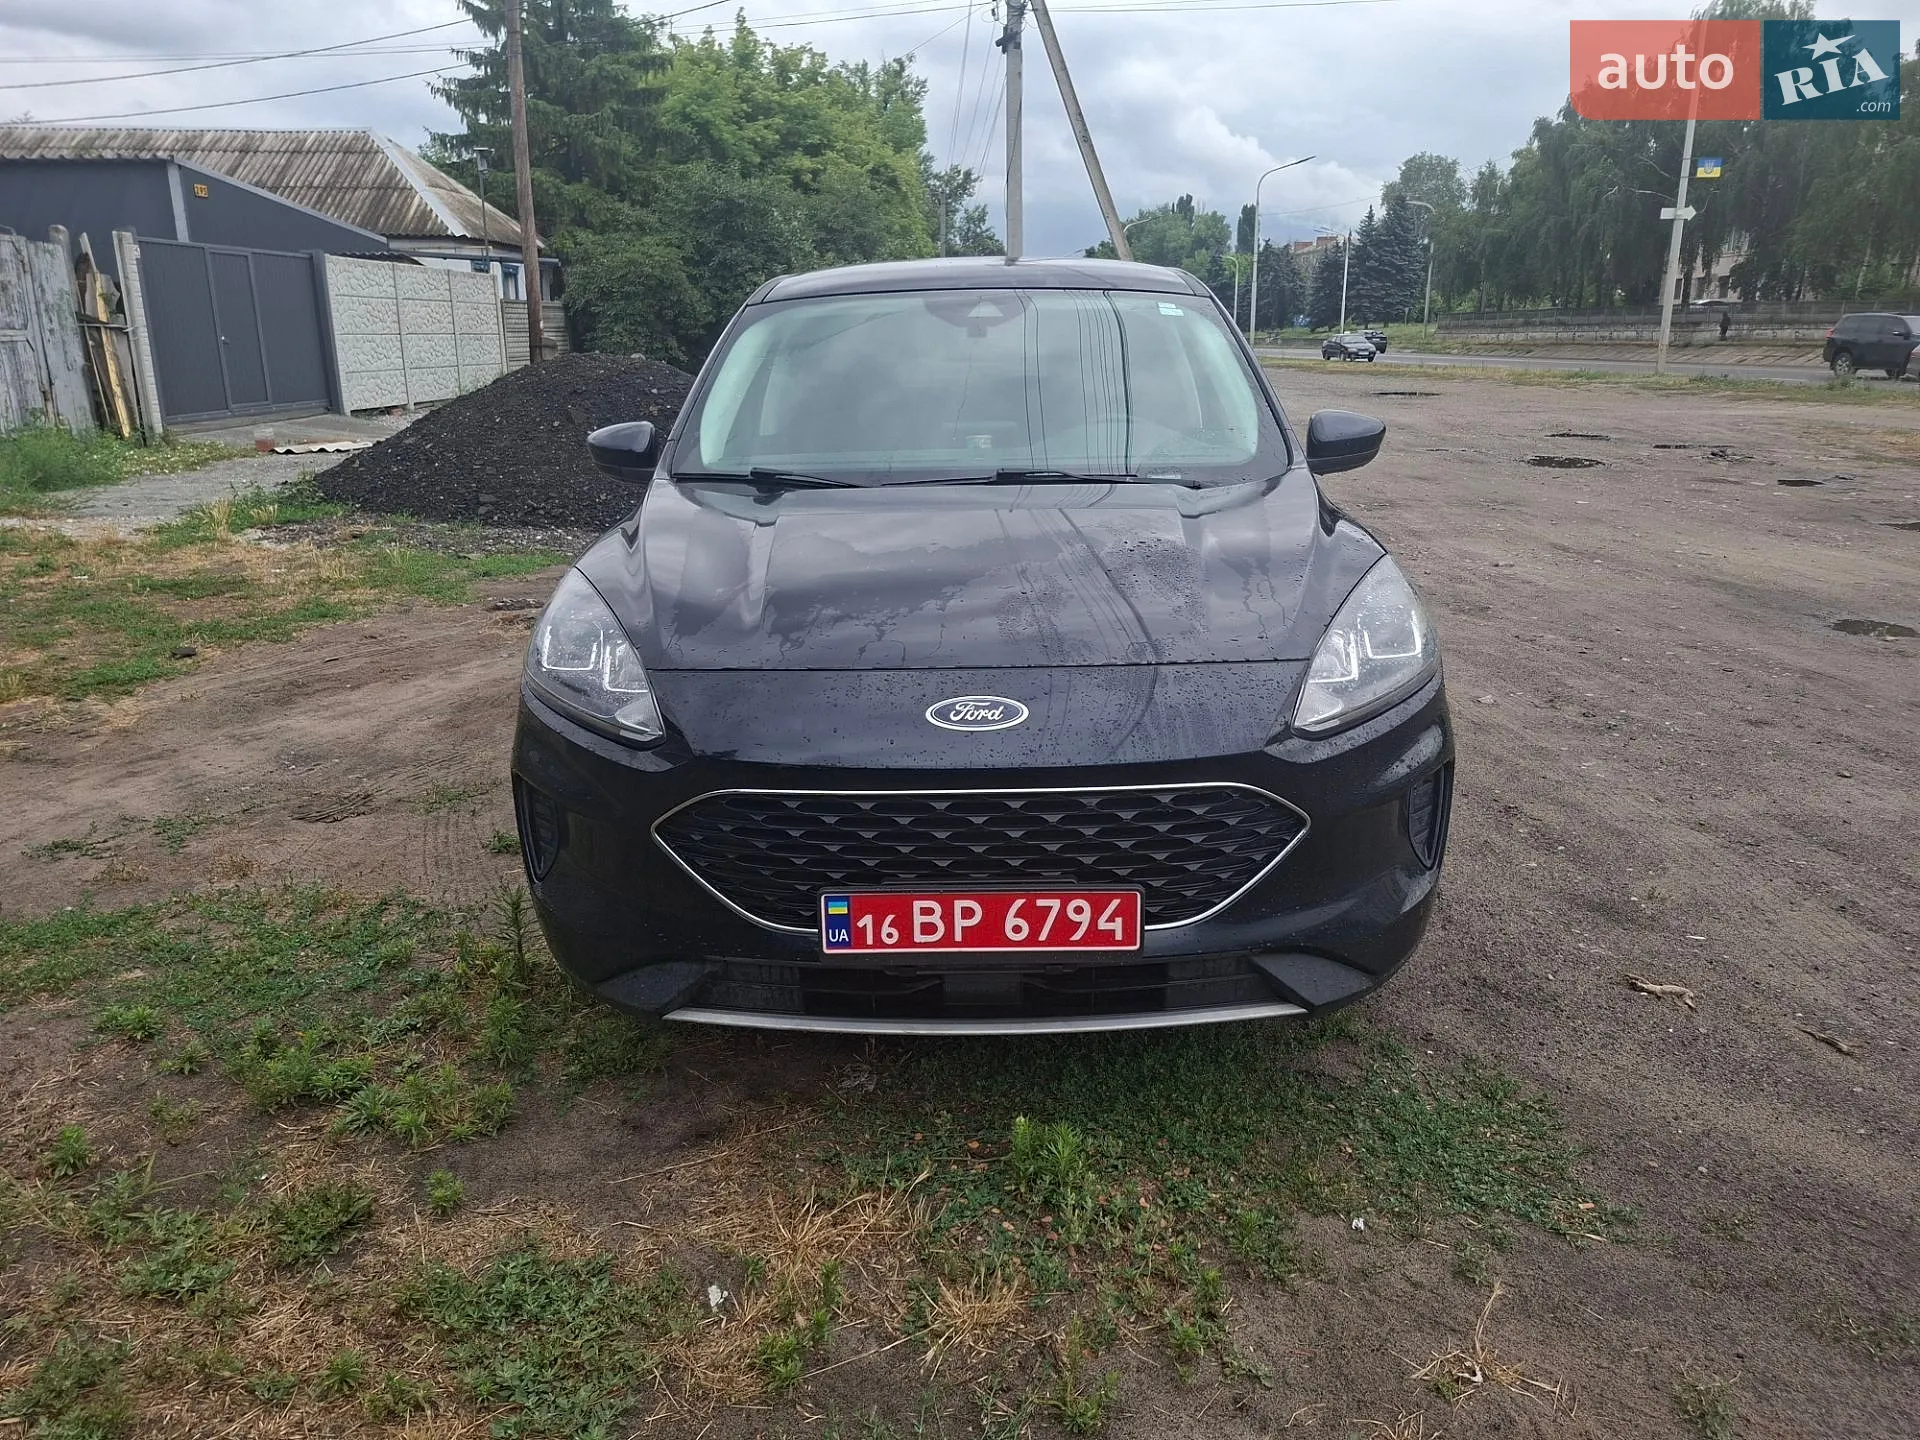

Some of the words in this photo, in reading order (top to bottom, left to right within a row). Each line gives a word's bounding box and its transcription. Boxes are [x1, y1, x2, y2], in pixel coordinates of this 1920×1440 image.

[950, 701, 1004, 721] Ford
[857, 914, 899, 945] 16
[1004, 899, 1123, 942] 6794
[829, 929, 849, 943] UA
